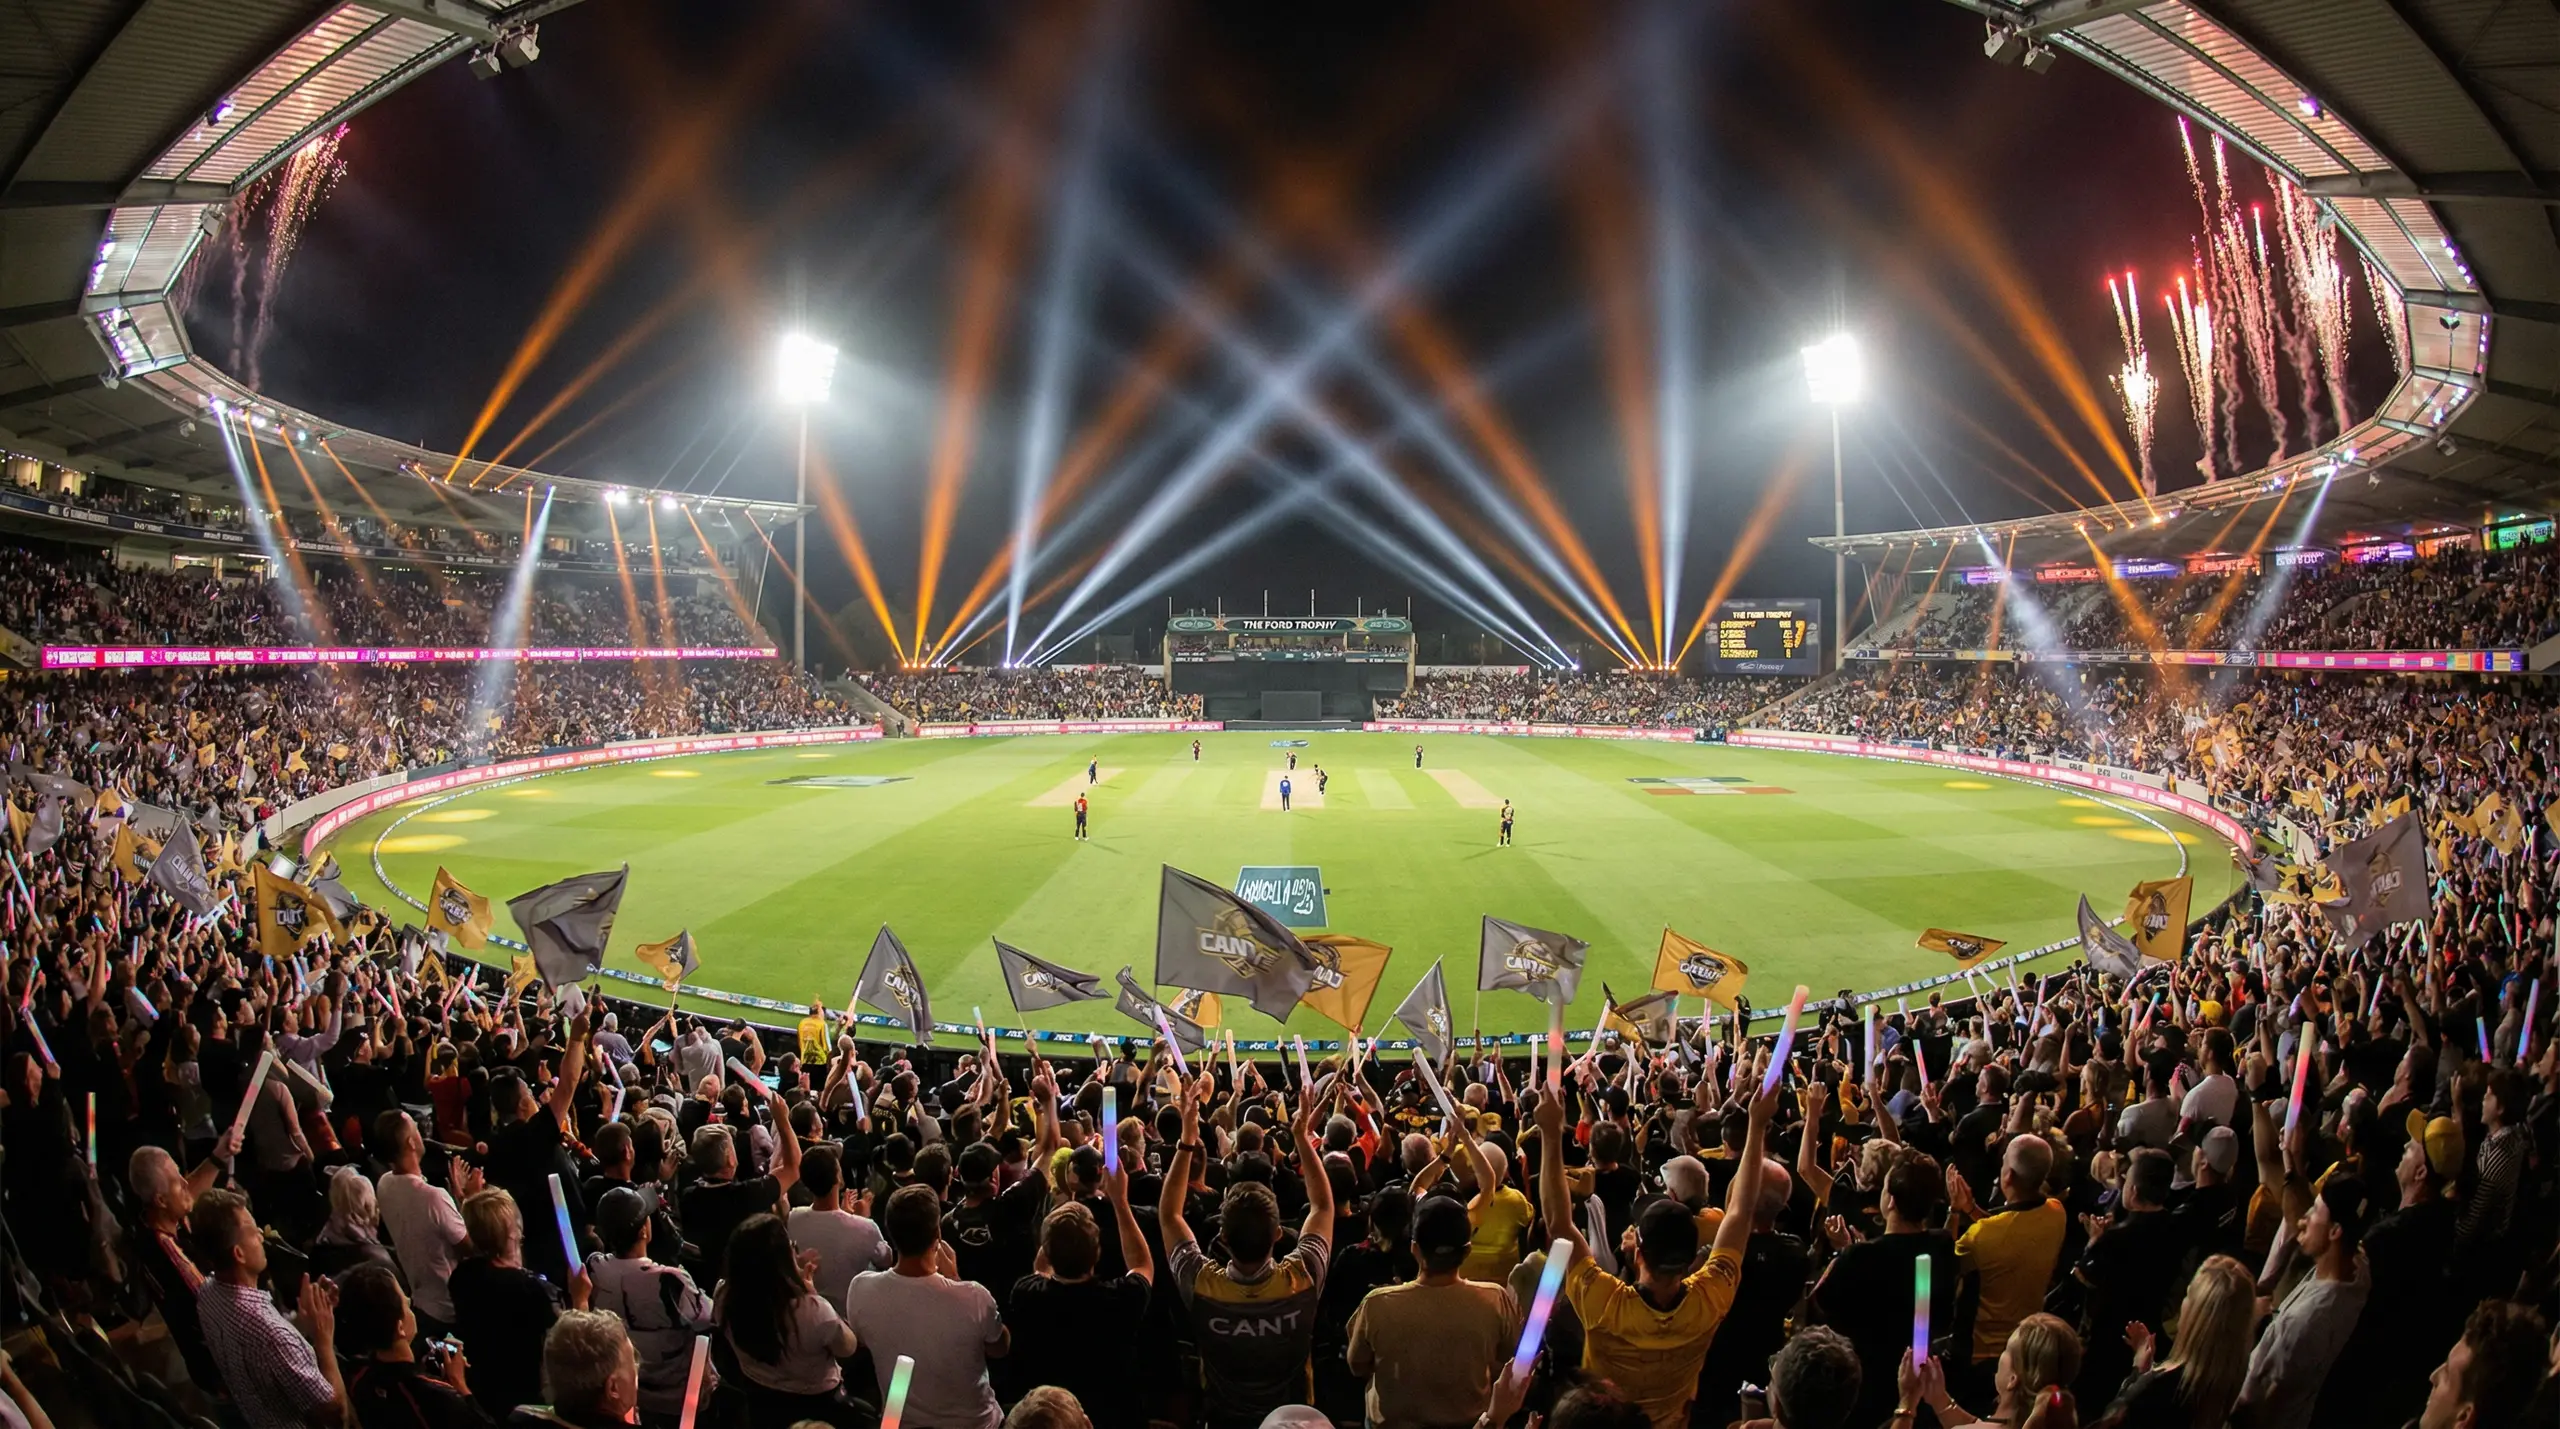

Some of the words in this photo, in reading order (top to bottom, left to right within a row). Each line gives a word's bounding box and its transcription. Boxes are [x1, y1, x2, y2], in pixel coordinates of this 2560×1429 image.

[1243, 620, 1263, 630] THE
[1264, 620, 1293, 630] FORD
[1208, 1309, 1301, 1337] CANT
